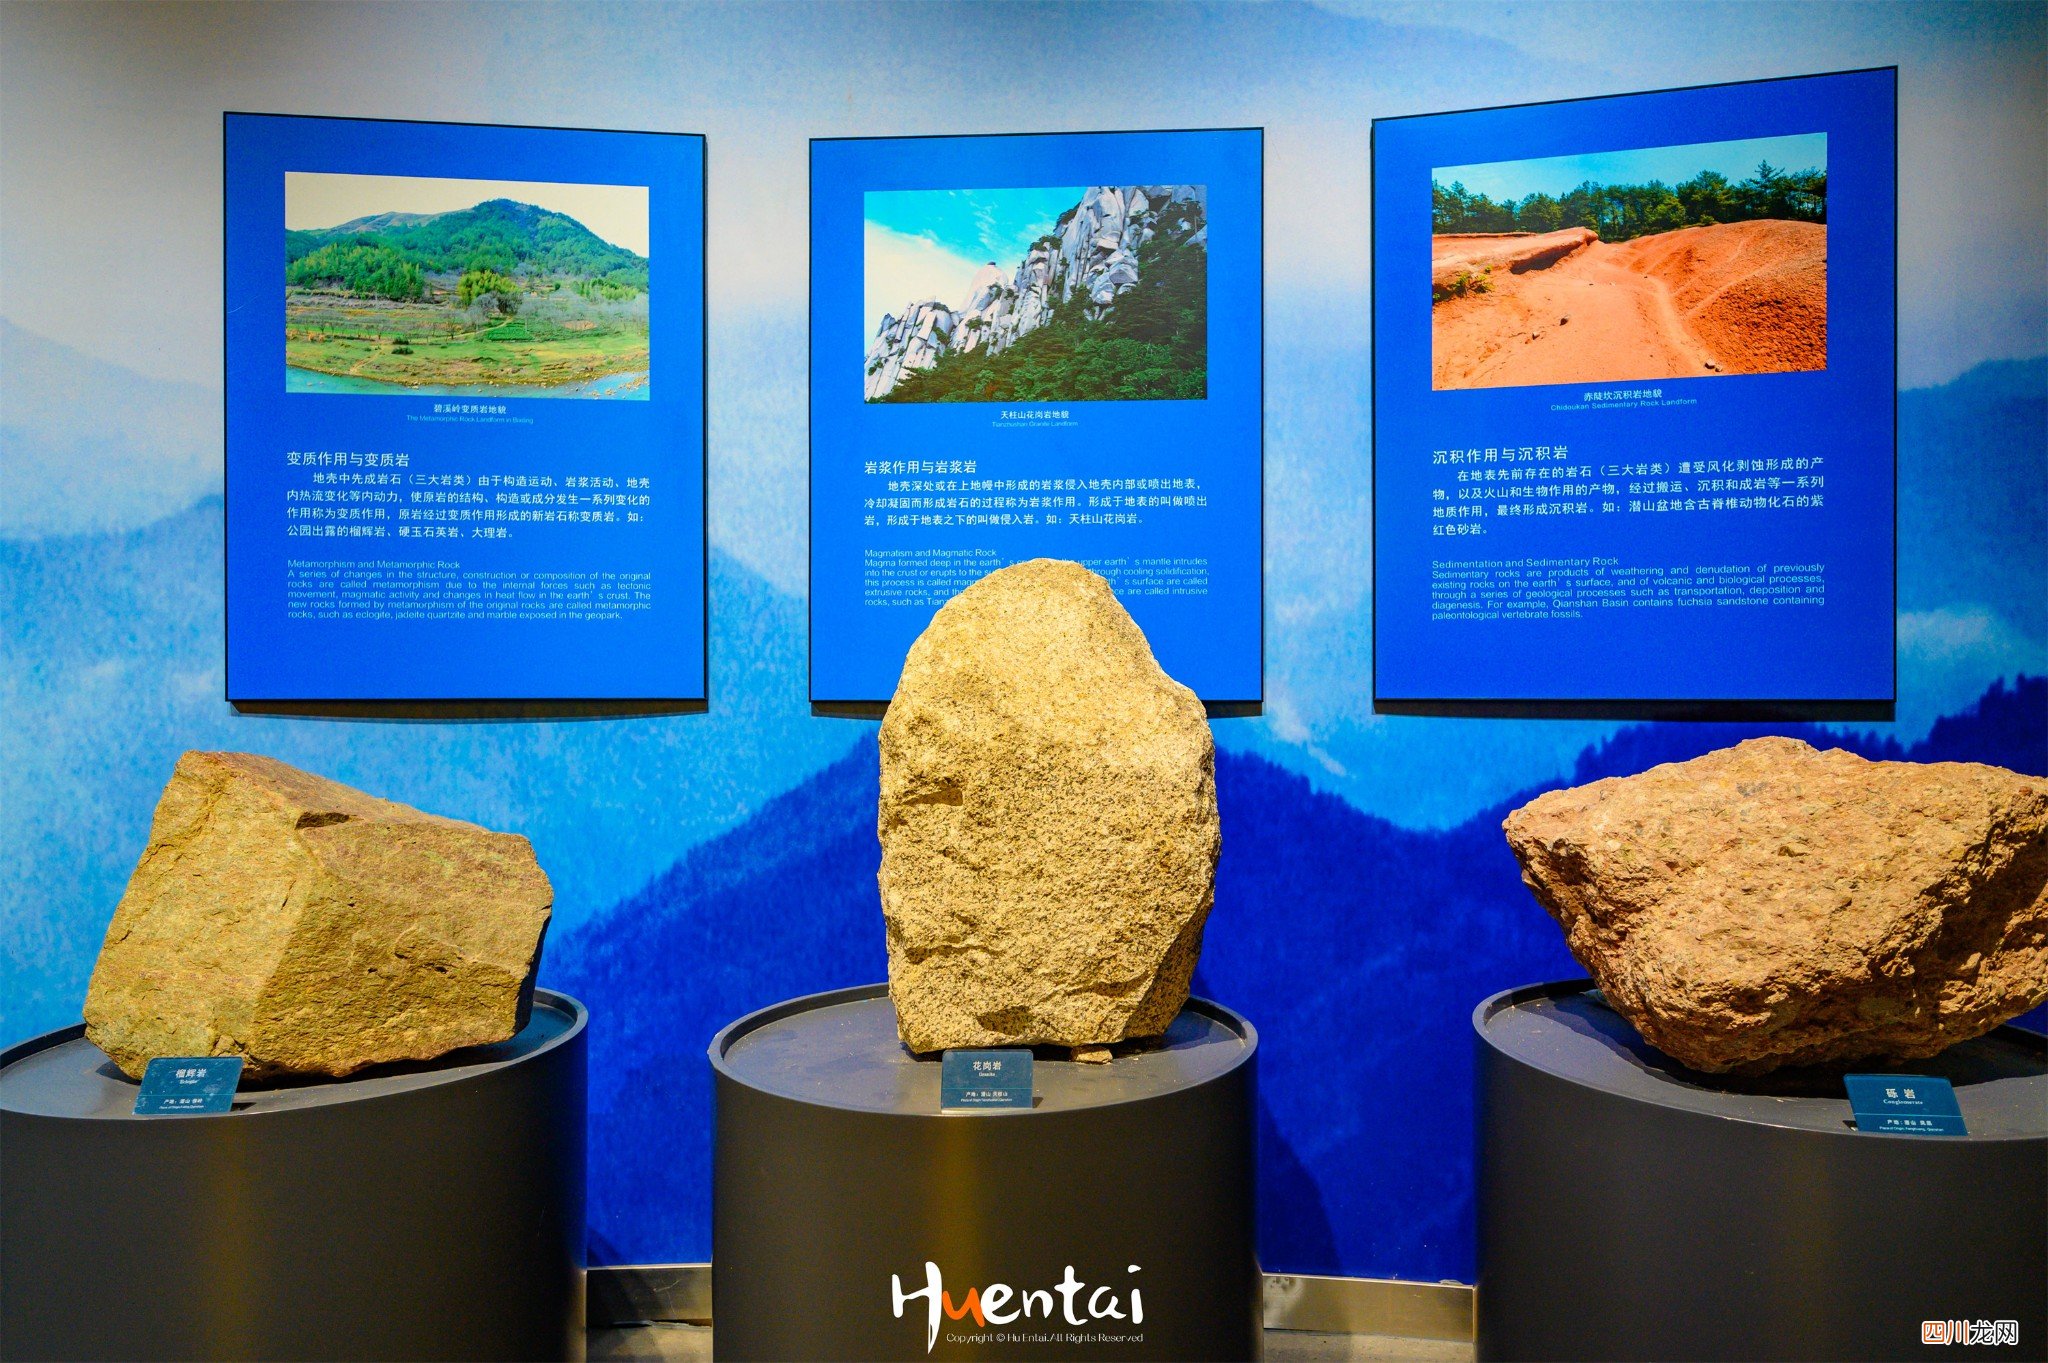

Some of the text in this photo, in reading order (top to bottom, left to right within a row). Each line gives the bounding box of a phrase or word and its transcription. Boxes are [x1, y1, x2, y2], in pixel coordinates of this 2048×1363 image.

[1583, 390, 1662, 402] 赤陡坎沉积岩地貌
[433, 404, 506, 415] 碧溪岭变质岩地貌
[1000, 410, 1069, 420] 天柱山花岗岩地貌
[286, 451, 409, 468] 变质作用与变质岩
[1432, 445, 1568, 465] 沉积作用与沉积岩
[864, 459, 976, 475] 岩浆作用与岩浆岩
[1432, 522, 1486, 536] 红色砂岩。
[972, 1061, 1002, 1071] 花岗岩
